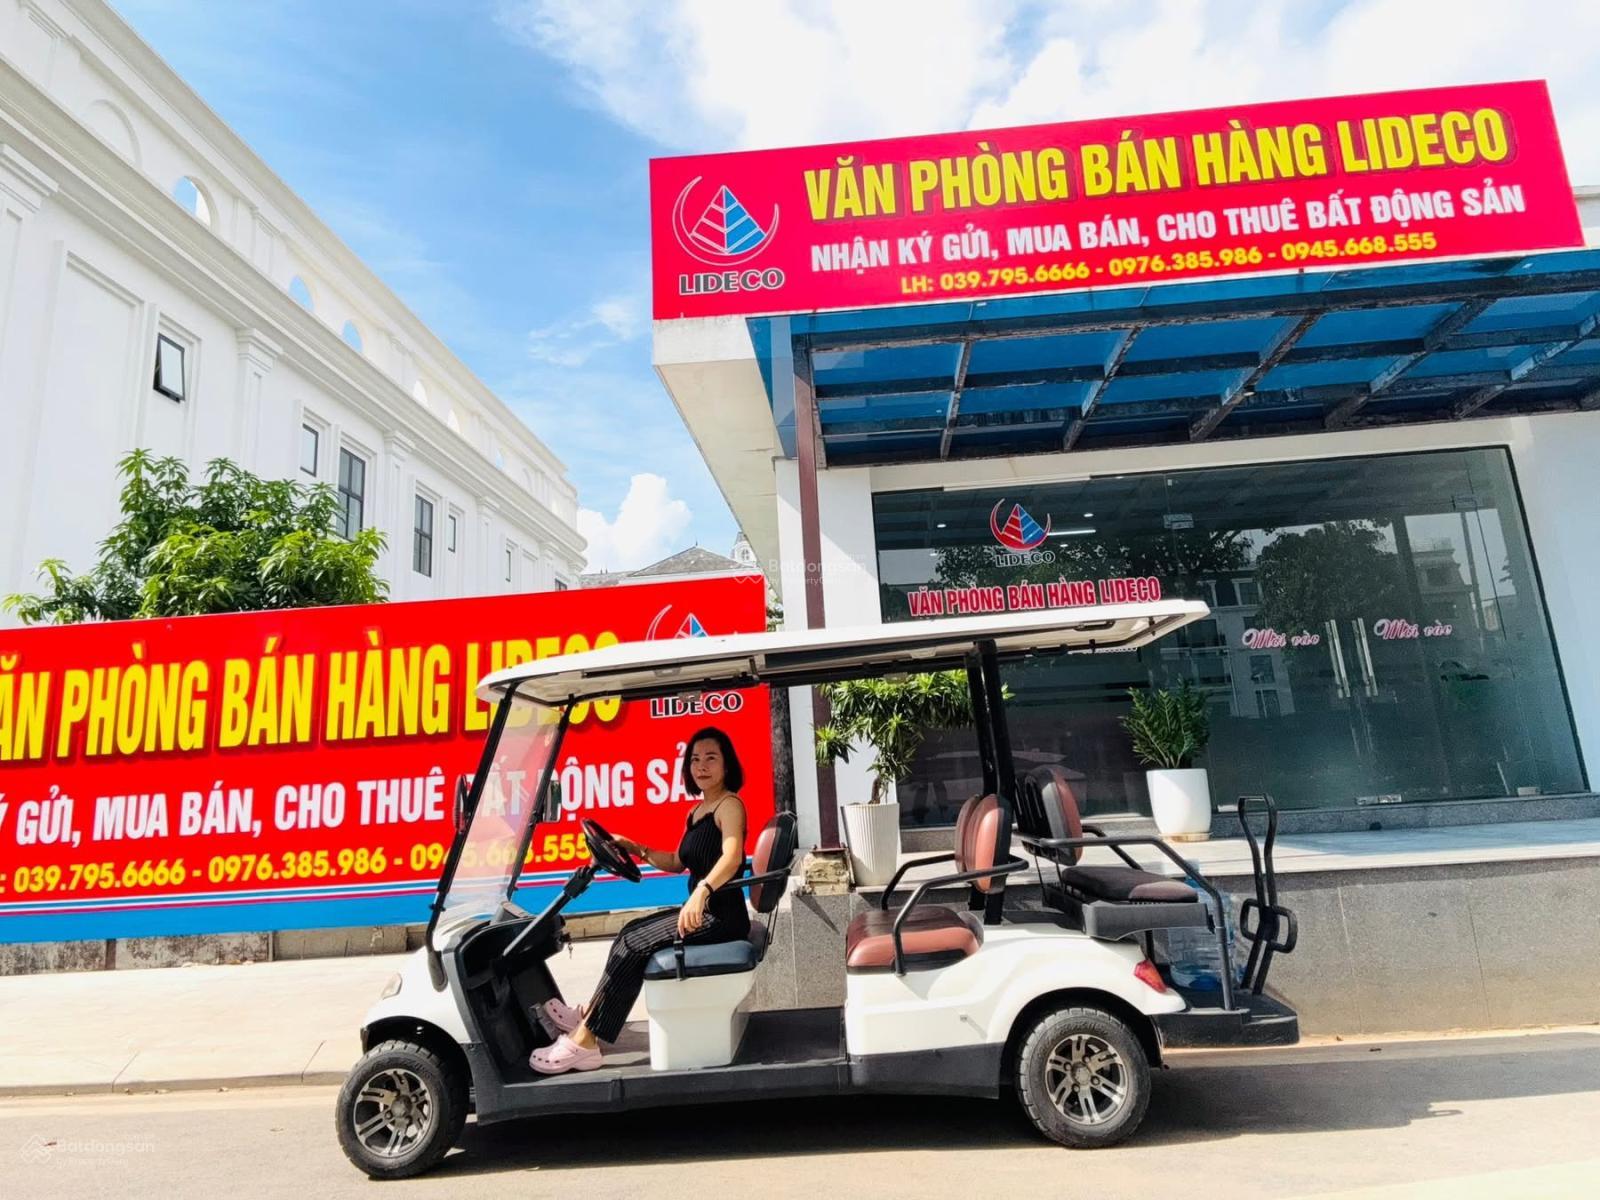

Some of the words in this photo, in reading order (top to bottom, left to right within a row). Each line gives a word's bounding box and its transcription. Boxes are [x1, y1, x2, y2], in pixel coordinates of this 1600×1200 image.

[803, 156, 896, 221] VĂN
[909, 142, 1069, 213] PHÒNG
[1080, 130, 1182, 197] BÁN
[1192, 120, 1328, 186] HÀNG
[1336, 108, 1509, 173] LIDECO
[811, 237, 891, 274] NHẬN
[898, 230, 934, 265] KÝ
[942, 223, 999, 262] GỬI,
[1006, 223, 1073, 256] MUA
[1078, 214, 1150, 250] BÁN,
[1156, 210, 1218, 242] CHO
[1223, 198, 1300, 236] THUÊ
[1306, 188, 1362, 229] BẤT
[1370, 188, 1456, 228] ĐỘNG
[1460, 177, 1527, 217] SẢN
[678, 267, 786, 296] LIDECO
[901, 274, 934, 295] LH:
[939, 260, 1091, 292] 039.795.6666
[1107, 246, 1263, 277] 0976.385.986
[1281, 231, 1438, 261] 0945.668.555
[995, 551, 1056, 568] LIDECO
[907, 585, 945, 617] VĂN
[944, 581, 1006, 615] PHÒNG
[1006, 579, 1045, 610] BÁN
[1046, 574, 1097, 608] HÀNG
[1098, 576, 1161, 606] LIDECO
[56, 642, 210, 756] PHÒNG
[219, 636, 315, 748] BÁN
[325, 629, 451, 741] HÀNG
[649, 690, 744, 719] LIDECO
[16, 784, 82, 848] GỬI,
[92, 793, 169, 842] MUA
[179, 780, 263, 839] BÁN,
[274, 782, 346, 832] CHO
[356, 766, 446, 826] THUÊ
[466, 756, 527, 818] ẤT
[645, 742, 704, 805] SẢ
[13, 858, 187, 894] 039.795.6666
[207, 847, 388, 884] 0976.385.986
[410, 833, 592, 872] 095.66.555
